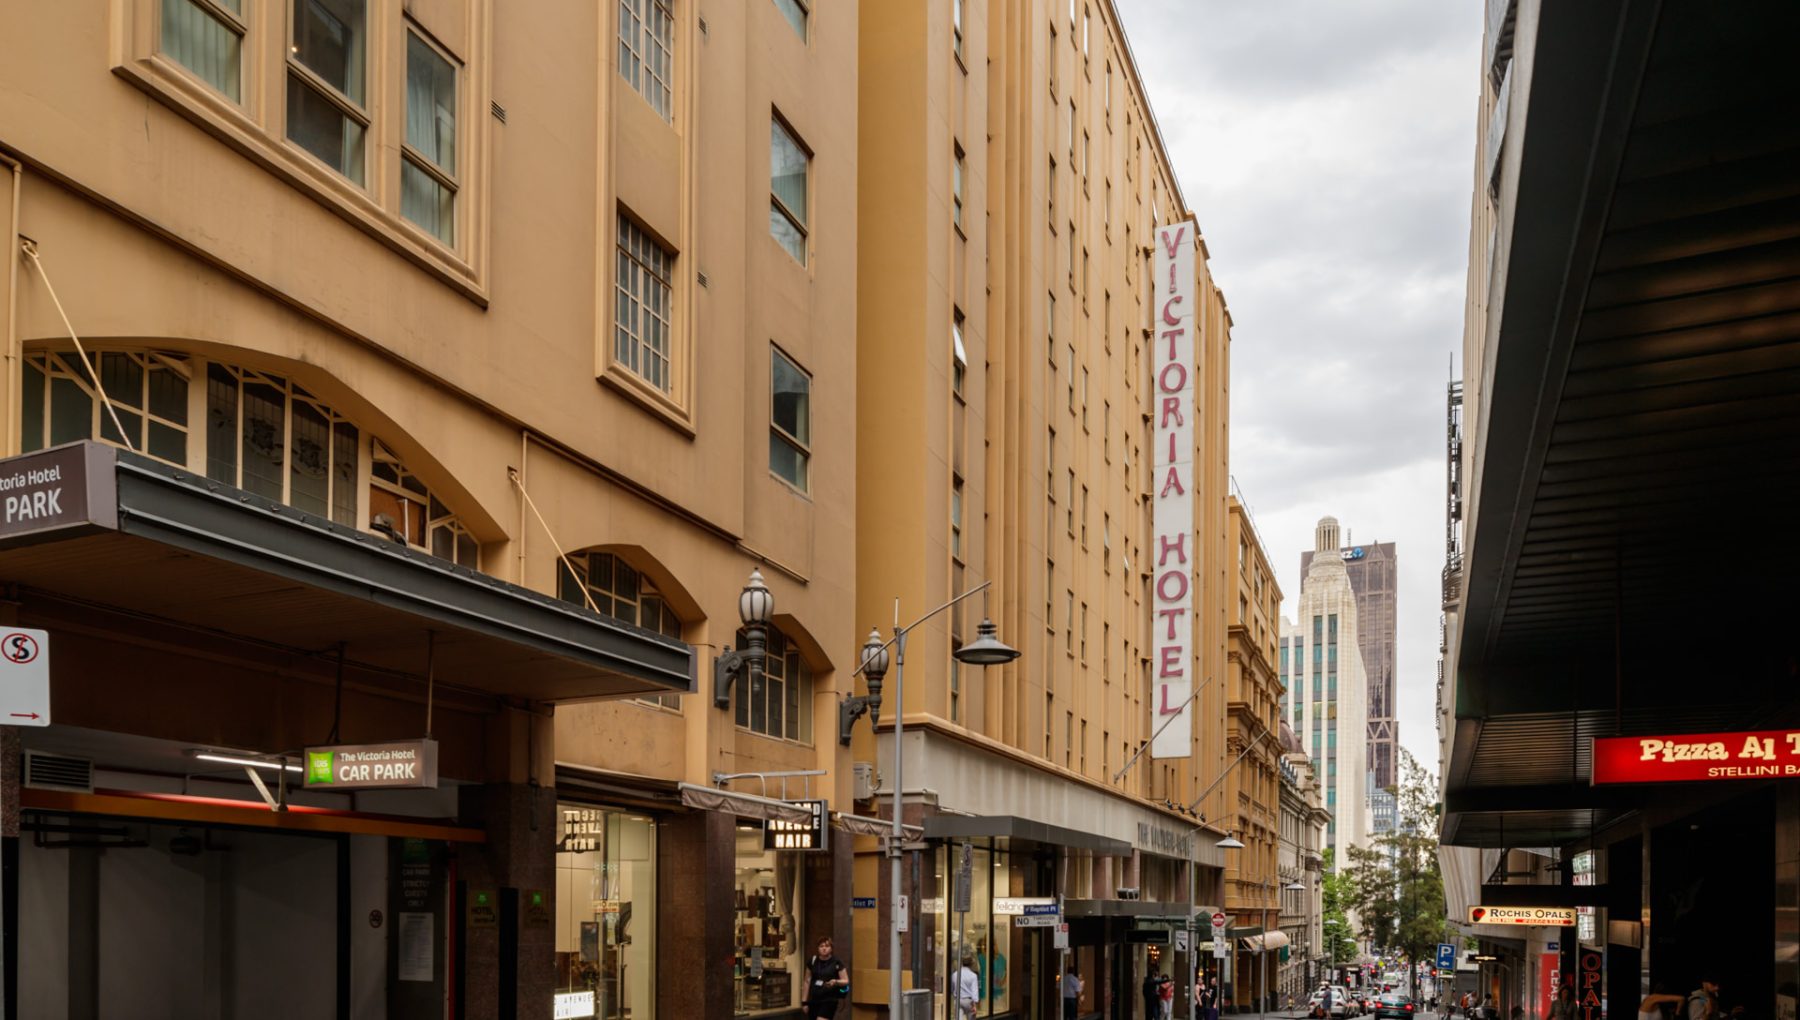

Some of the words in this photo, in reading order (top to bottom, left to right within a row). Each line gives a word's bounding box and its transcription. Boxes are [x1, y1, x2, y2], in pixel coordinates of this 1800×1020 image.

[1159, 227, 1187, 497] VICTORIA
[0, 472, 26, 491] toria
[28, 465, 61, 486] Hotel
[6, 487, 62, 523] PARK
[1157, 533, 1188, 715] HOTEL
[341, 752, 356, 762] The
[357, 750, 390, 761] Victoria
[392, 749, 416, 759] Hotel
[1640, 739, 1729, 762] Pizza
[1738, 736, 1776, 760] Al
[340, 765, 370, 781] CAR
[374, 762, 416, 780] PARK
[1708, 766, 1779, 777] STELLINI
[775, 834, 811, 848] HAIR
[1016, 917, 1029, 926] NO
